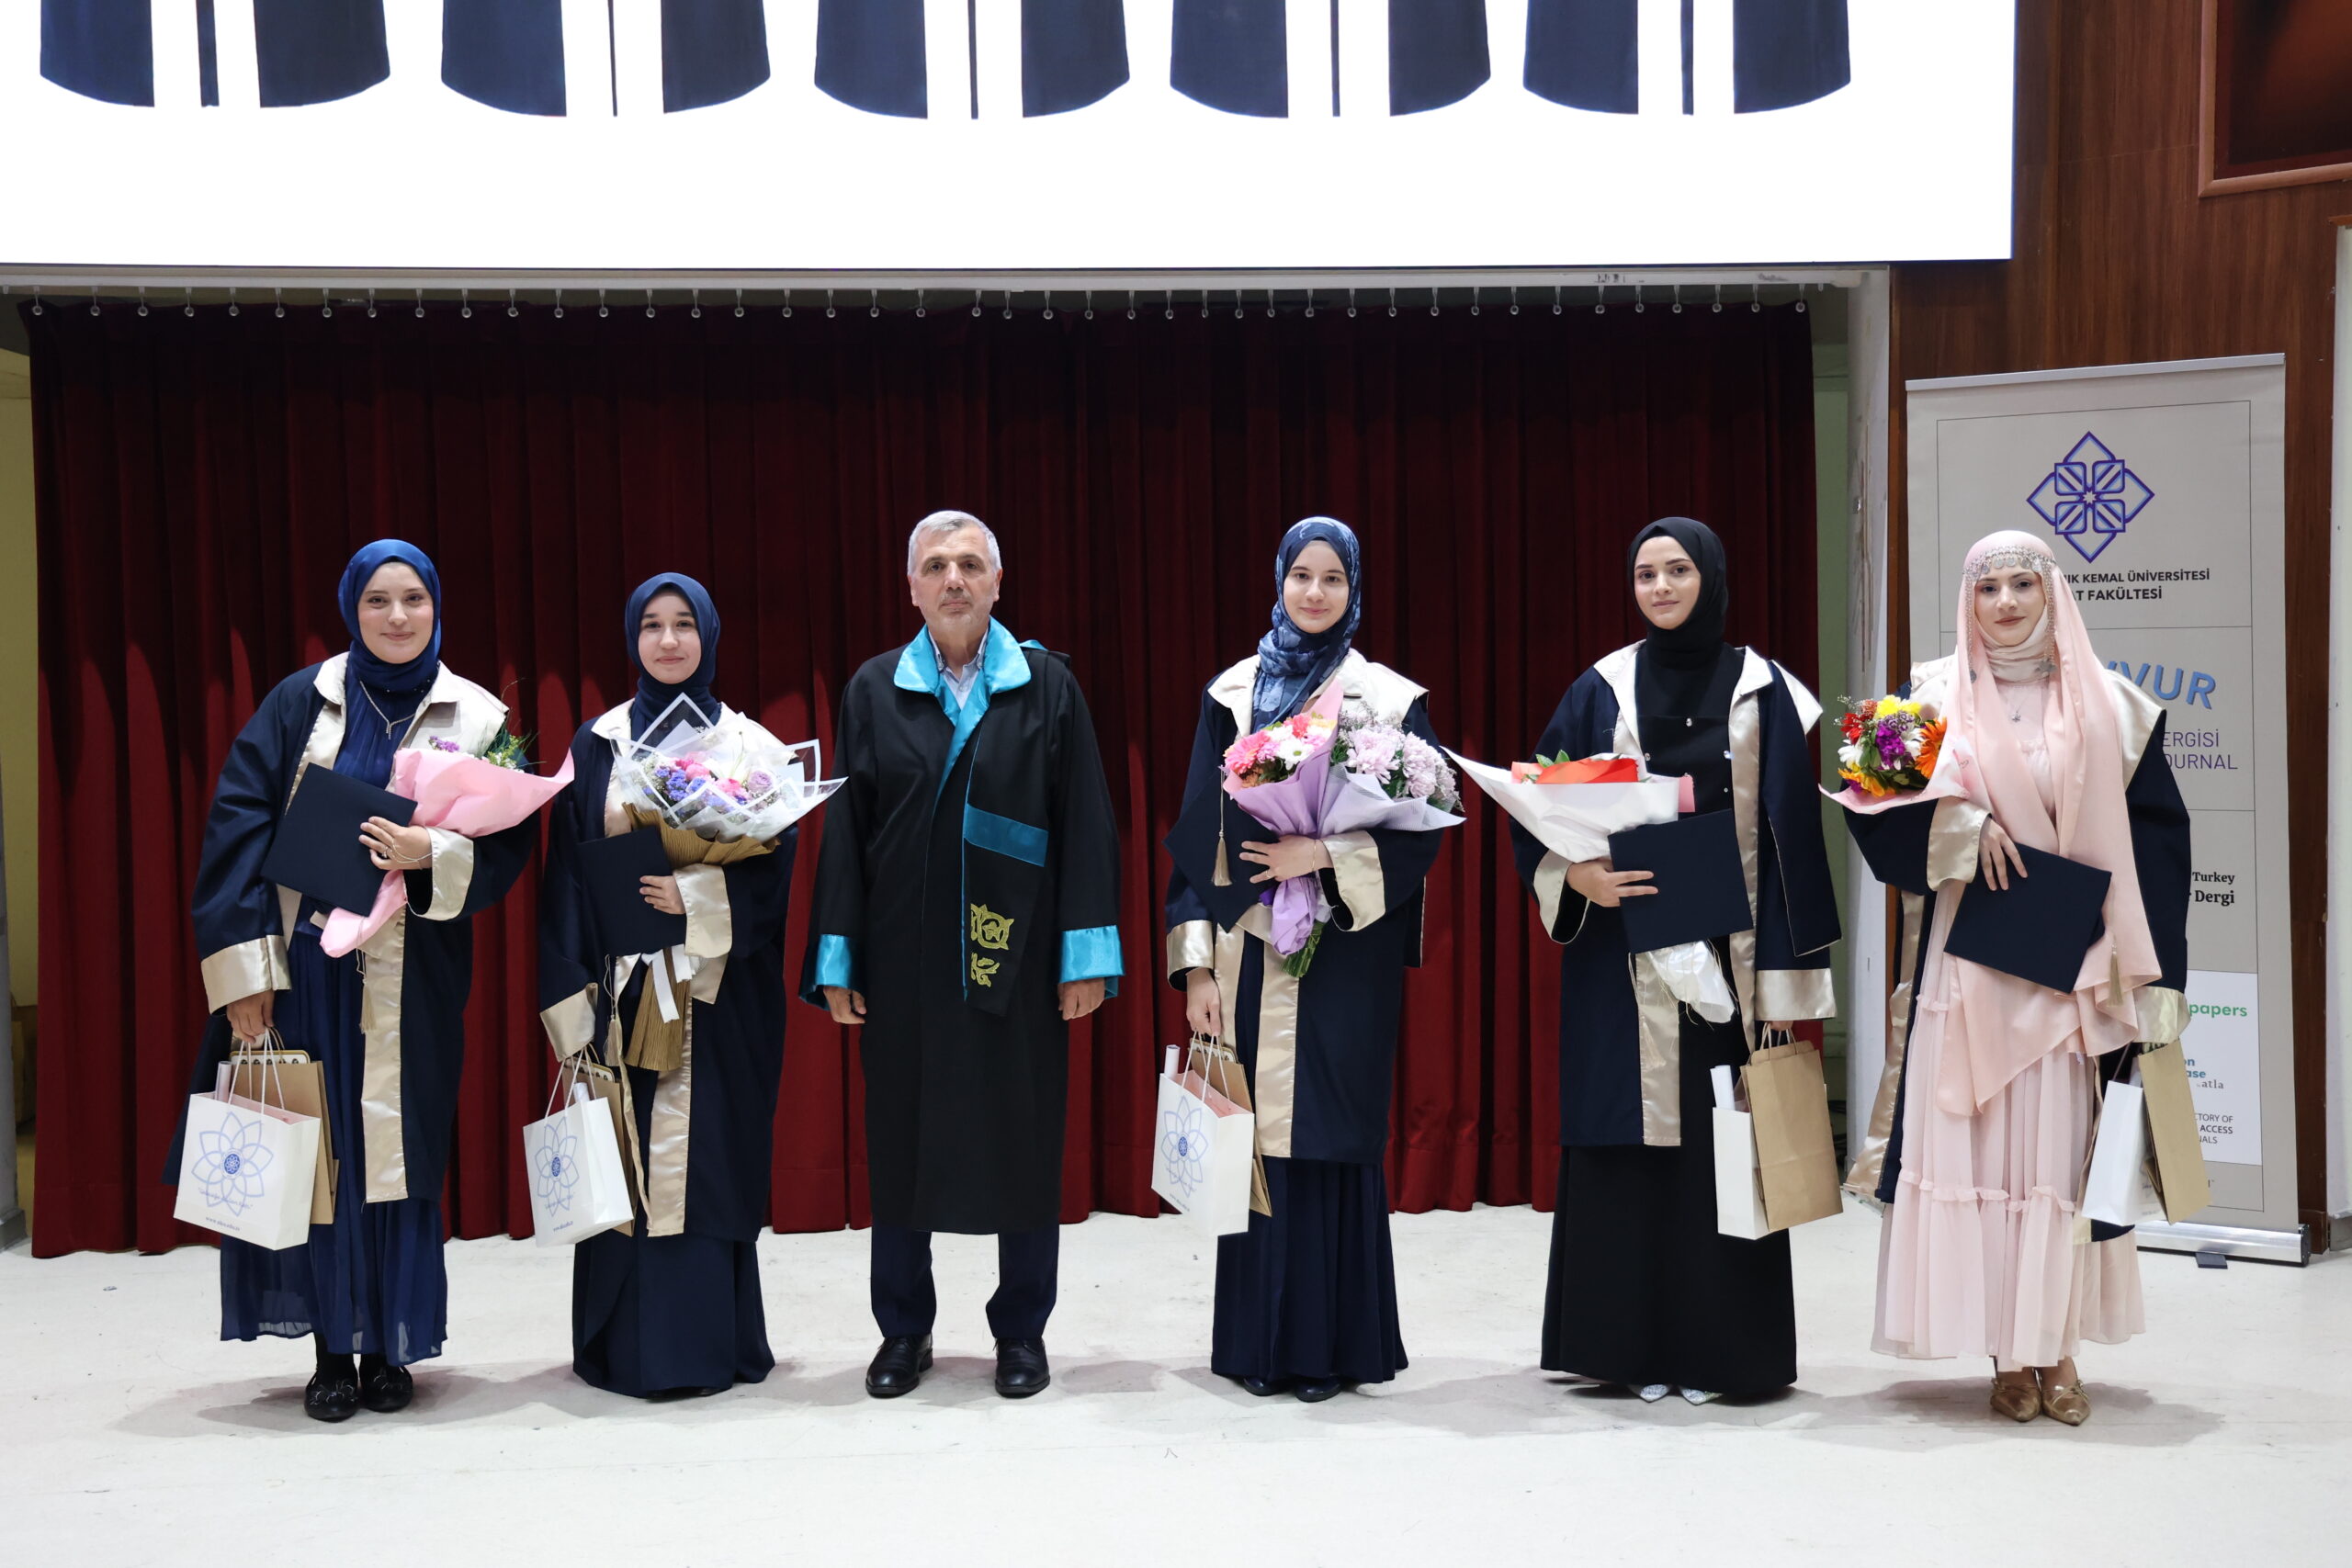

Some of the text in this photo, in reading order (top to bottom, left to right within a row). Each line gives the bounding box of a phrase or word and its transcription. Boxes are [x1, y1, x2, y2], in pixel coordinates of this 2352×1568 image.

[2083, 572, 2124, 583] KEMAL
[2127, 568, 2211, 582] ÜNİVERSİTESİ
[2087, 585, 2163, 601] FAKÜLTESİ
[2192, 872, 2235, 886] Turkey
[2195, 890, 2234, 907] Dergi
[2188, 1004, 2248, 1019] papers
[2201, 1079, 2224, 1089] atla
[2199, 1124, 2233, 1134] ACCESS
